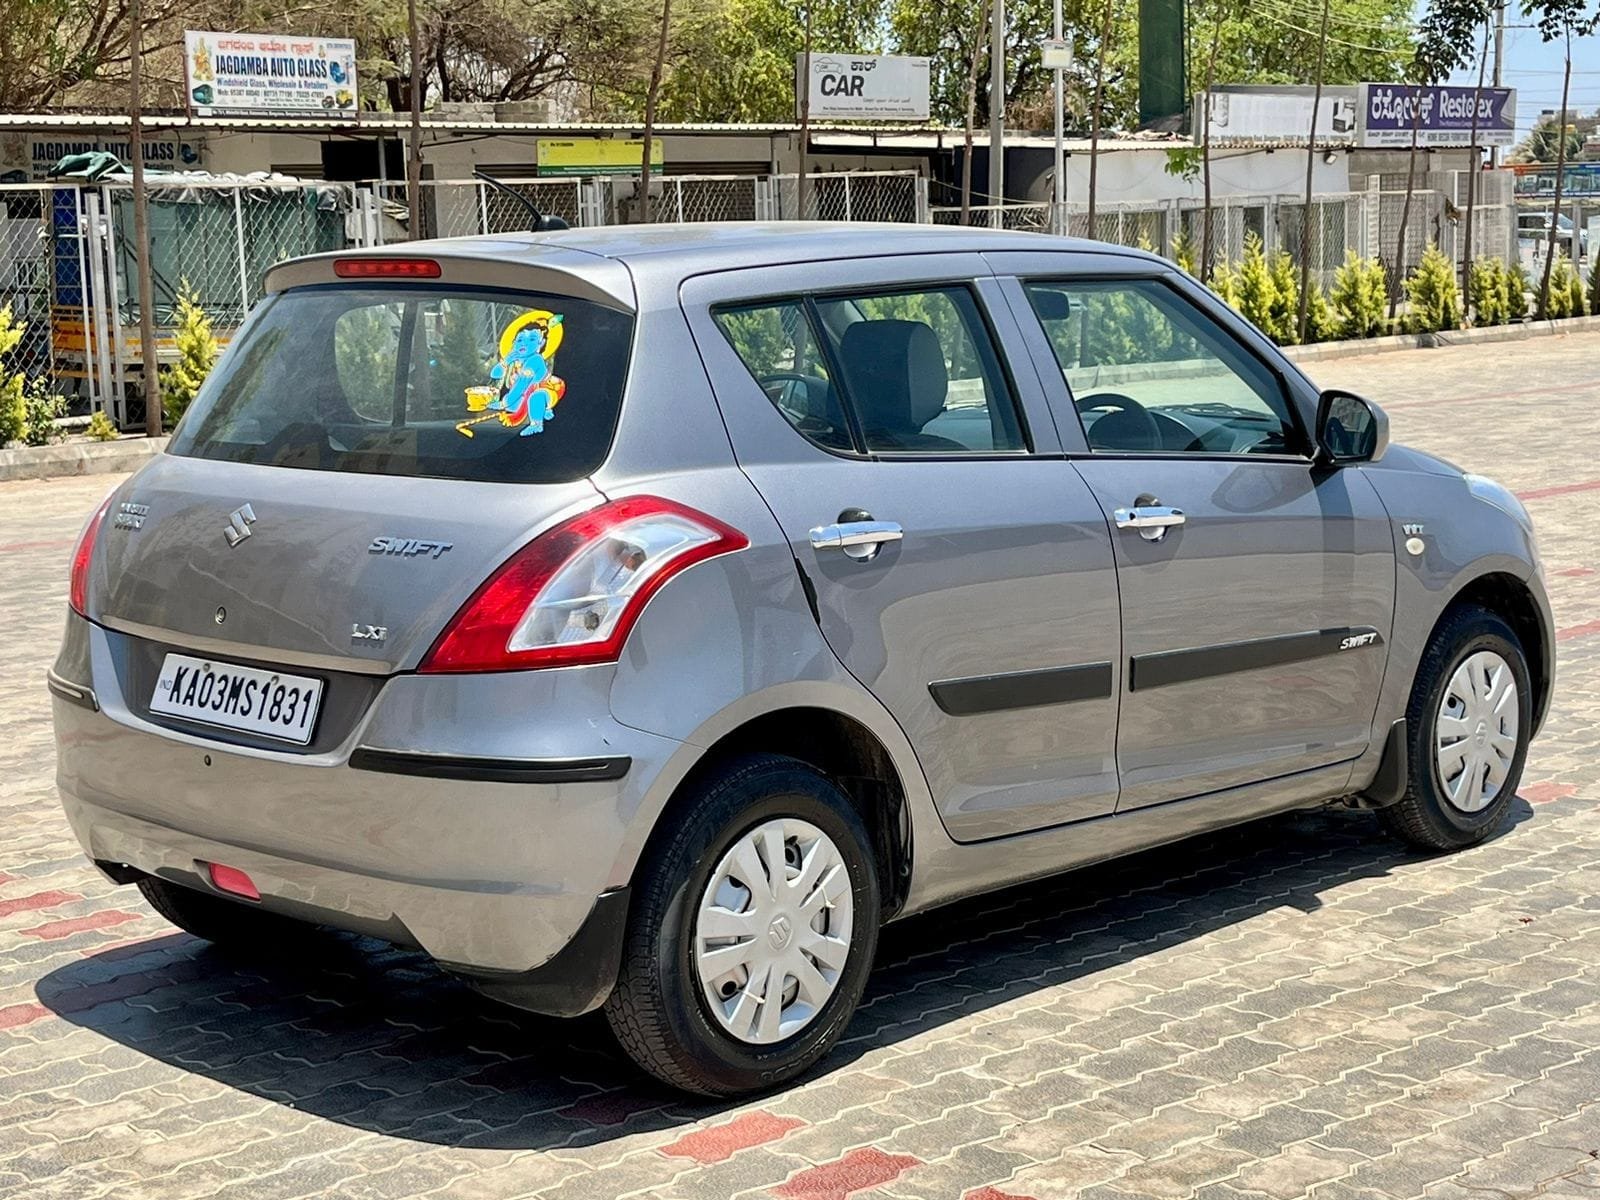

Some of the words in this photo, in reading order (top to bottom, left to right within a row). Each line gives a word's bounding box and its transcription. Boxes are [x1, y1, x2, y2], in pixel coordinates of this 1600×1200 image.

[215, 55, 269, 76] JAGDAMBA
[270, 57, 296, 77] AUTO
[297, 59, 328, 78] GLASS
[850, 59, 877, 71] ಕಾರ್
[216, 78, 248, 87] Windshield
[268, 80, 296, 88] Wholesale
[304, 80, 328, 90] Retailers
[820, 74, 865, 97] CAR
[368, 536, 454, 559] SWIFT
[1340, 632, 1377, 650] SWIFT
[168, 666, 314, 729] KA03MS1831
